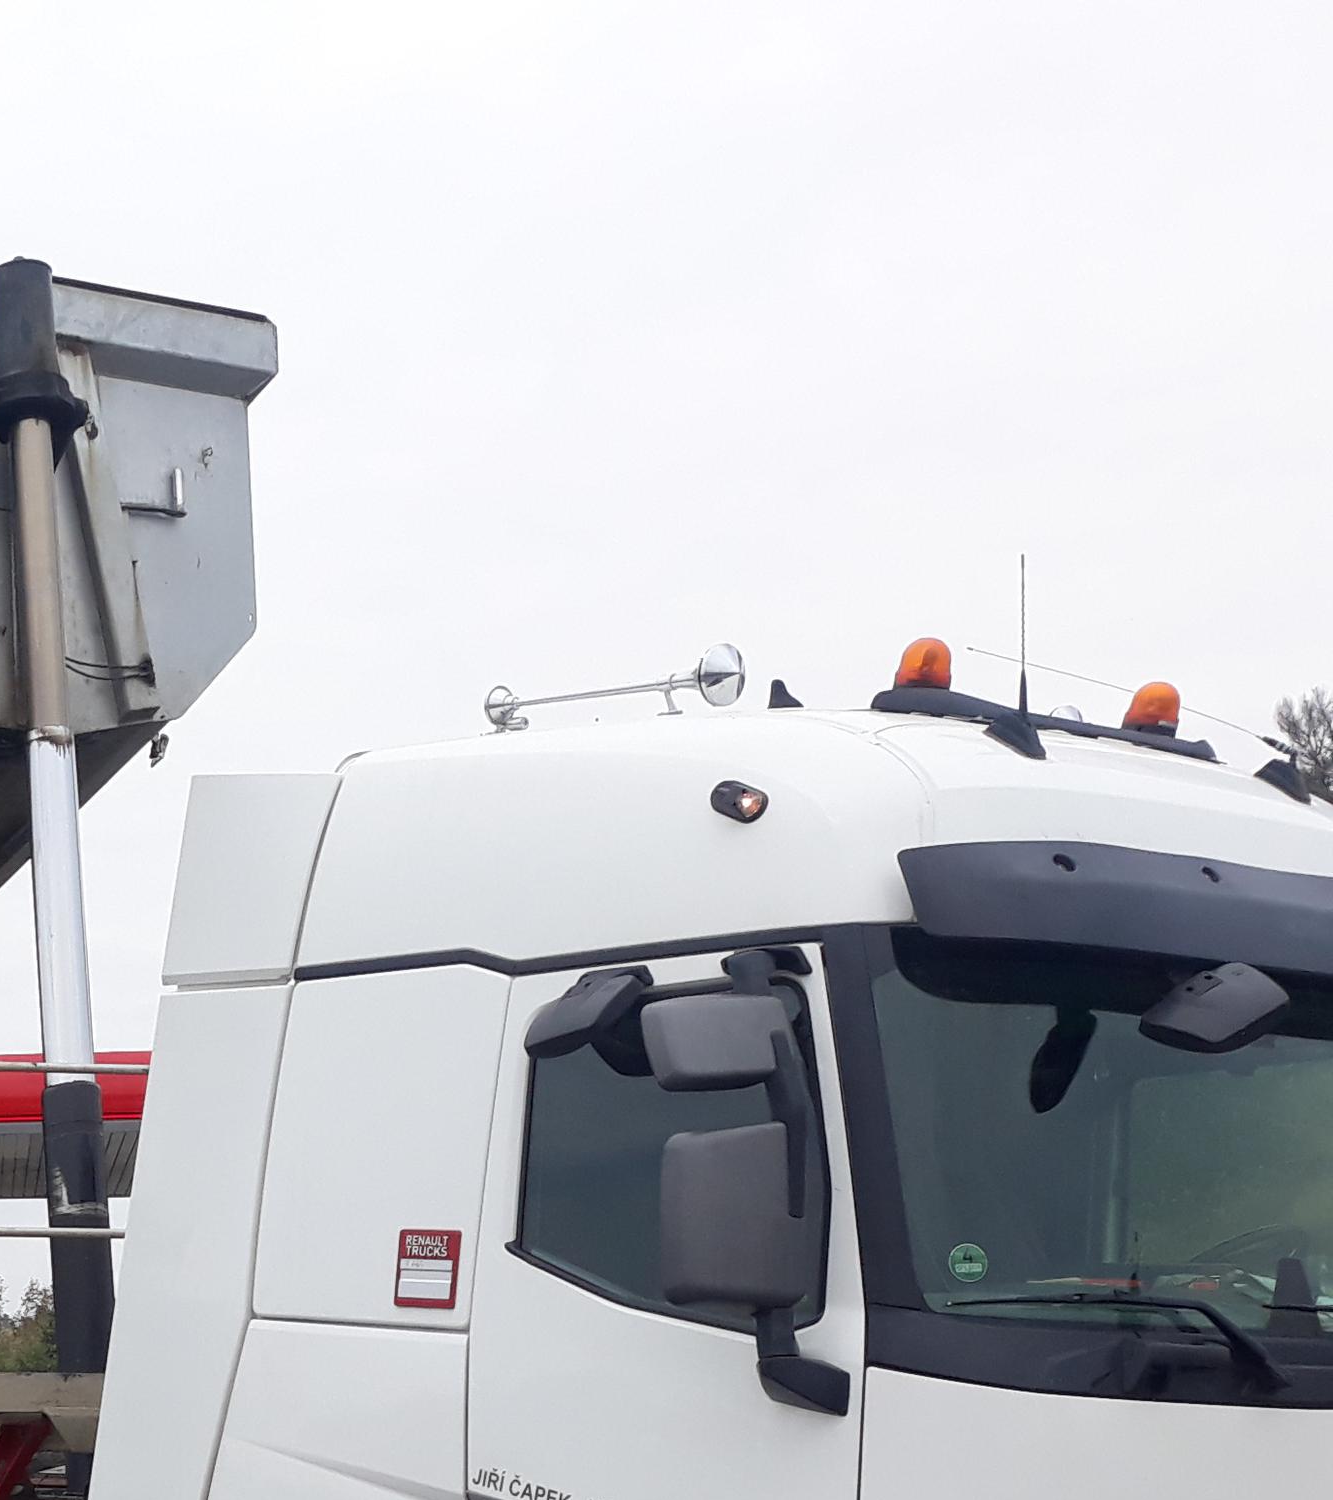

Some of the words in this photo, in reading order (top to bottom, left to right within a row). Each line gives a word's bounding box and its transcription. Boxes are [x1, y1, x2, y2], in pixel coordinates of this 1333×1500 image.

[405, 1234, 449, 1246] RENAULT
[406, 1246, 448, 1257] TRUCKS
[472, 1468, 506, 1492] JIŘÍ
